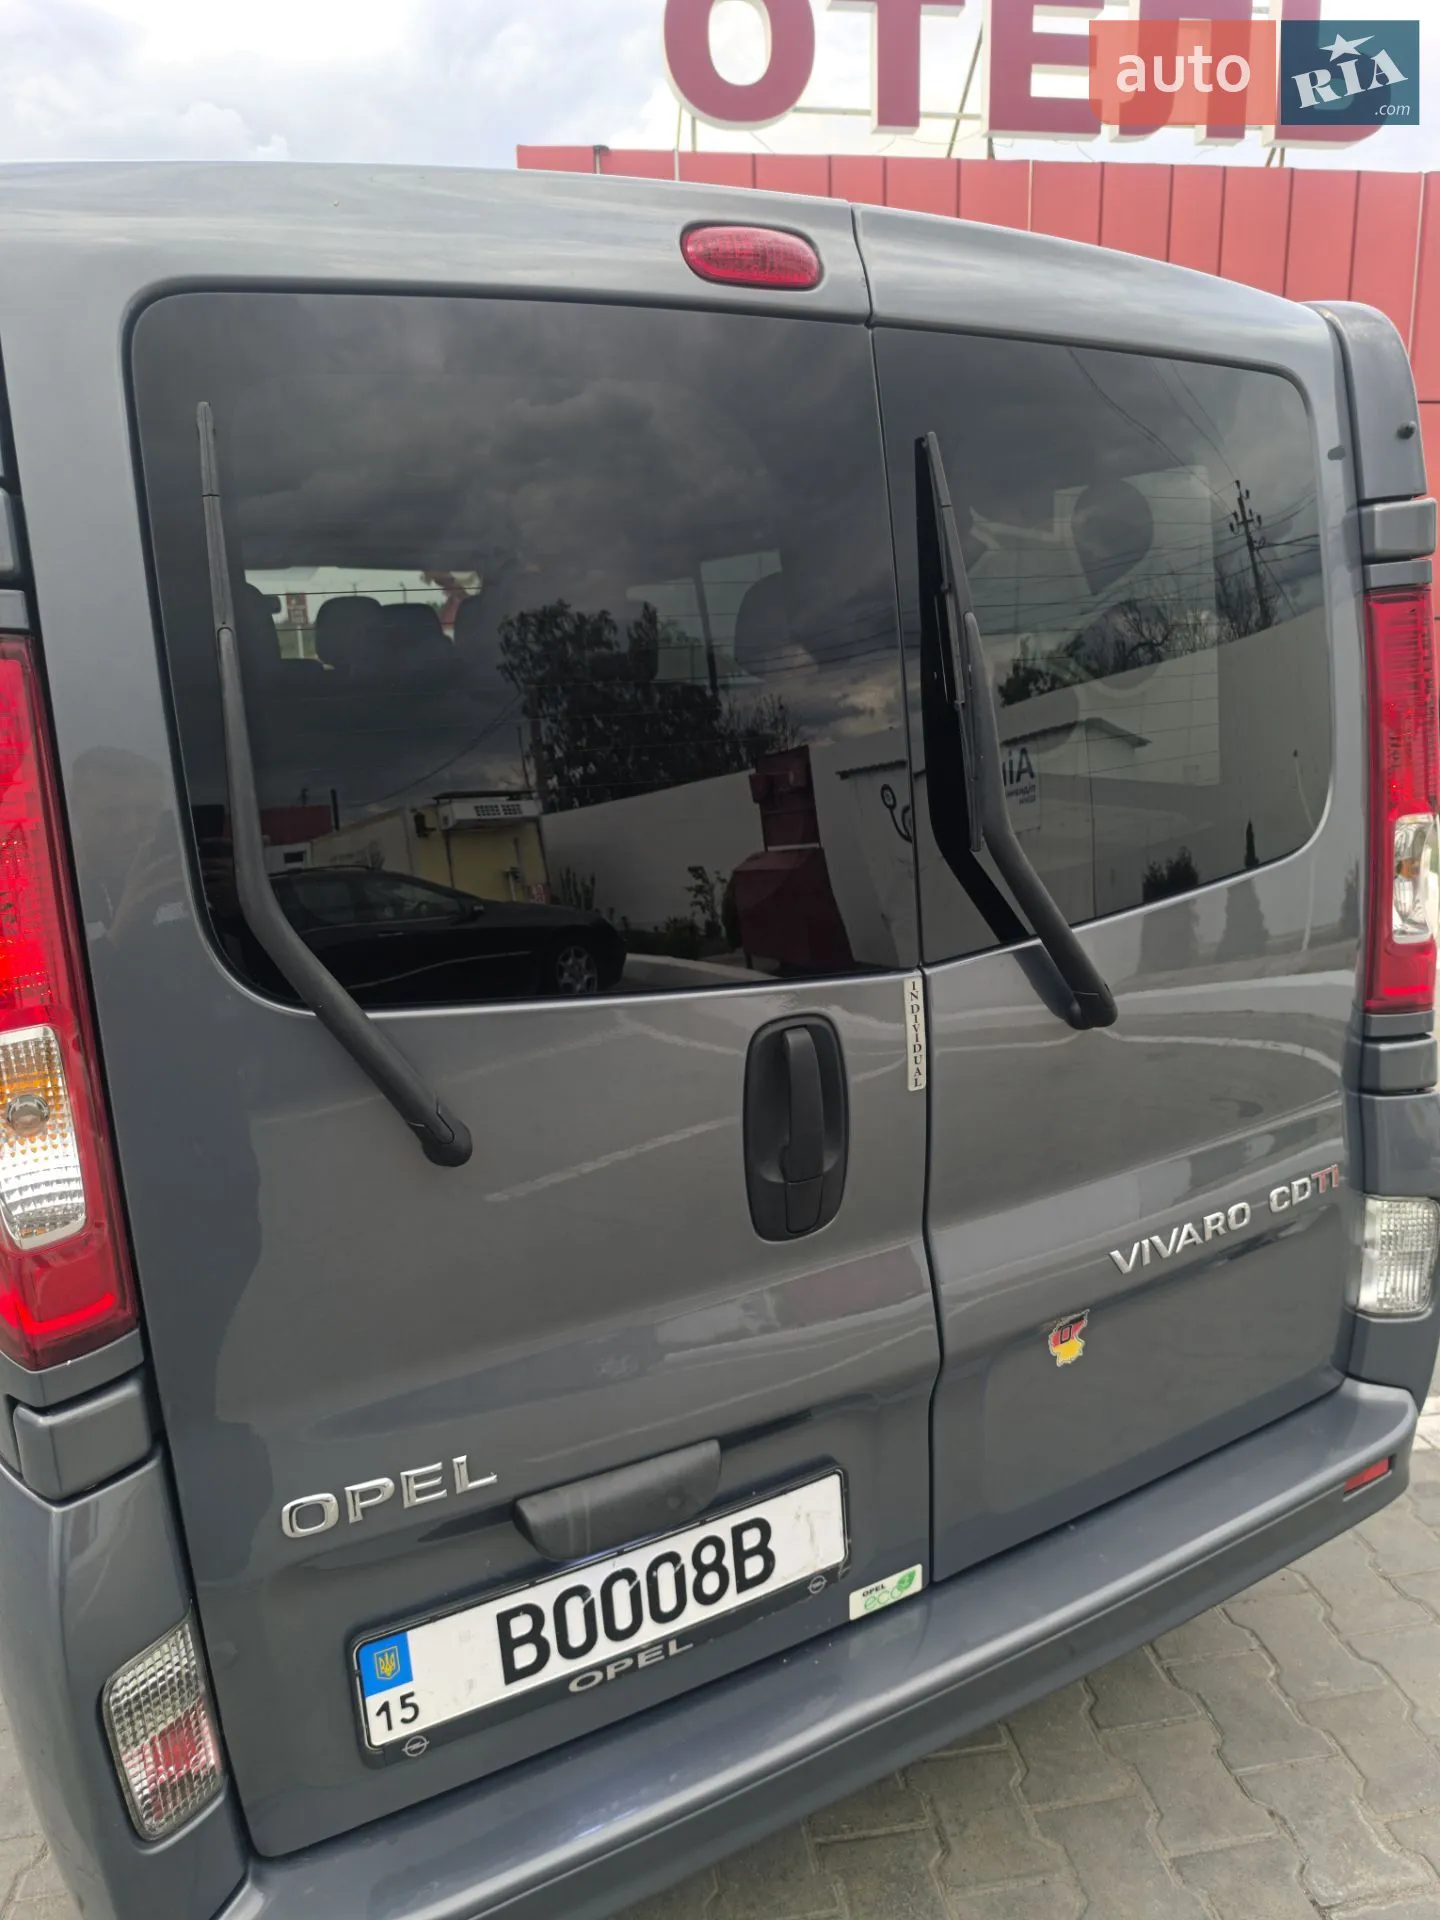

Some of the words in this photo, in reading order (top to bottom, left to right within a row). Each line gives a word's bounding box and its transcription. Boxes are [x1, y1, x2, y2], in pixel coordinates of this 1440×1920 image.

[909, 980, 923, 1088] INDIVIDUAL
[1109, 1202, 1251, 1275] VIVARO
[1268, 1163, 1340, 1214] CDTI
[282, 1454, 498, 1539] OPEL
[862, 1583, 886, 1598] OPEL
[568, 1639, 694, 1693] OPEL
[375, 1690, 420, 1732] 15
